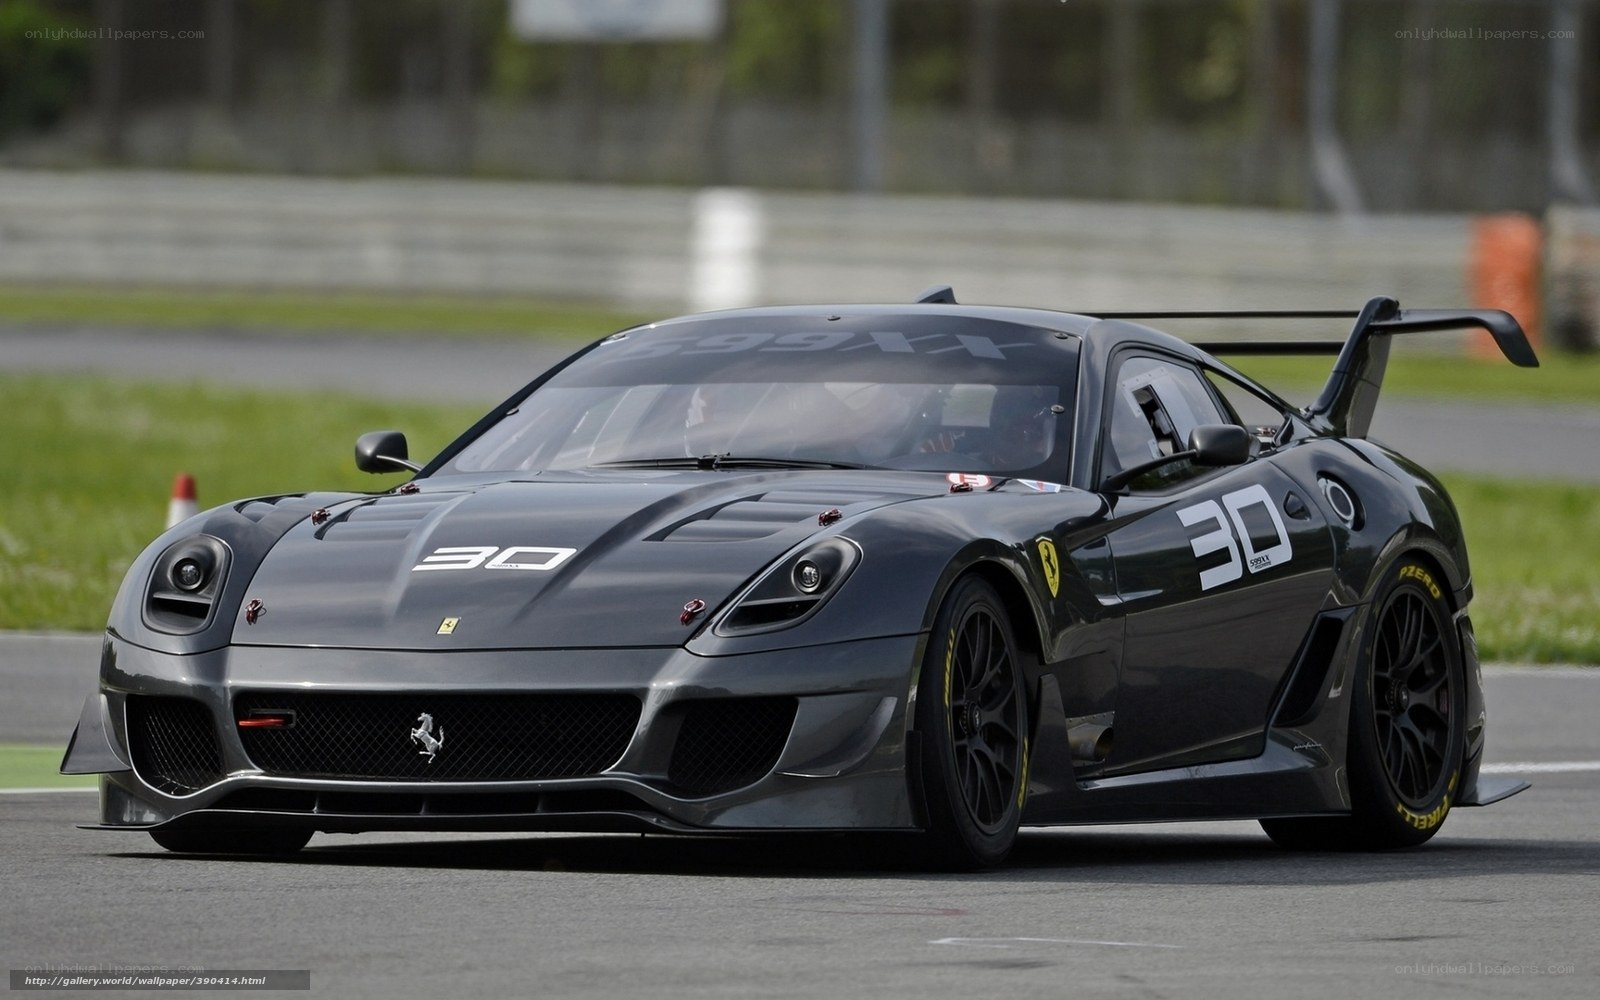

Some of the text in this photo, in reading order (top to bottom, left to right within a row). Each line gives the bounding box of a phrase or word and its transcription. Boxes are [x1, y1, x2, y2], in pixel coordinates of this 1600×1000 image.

[602, 331, 1037, 362] 599XX
[1176, 484, 1292, 591] 30
[412, 546, 577, 571] 30
[1397, 794, 1448, 829] PIRELLI
